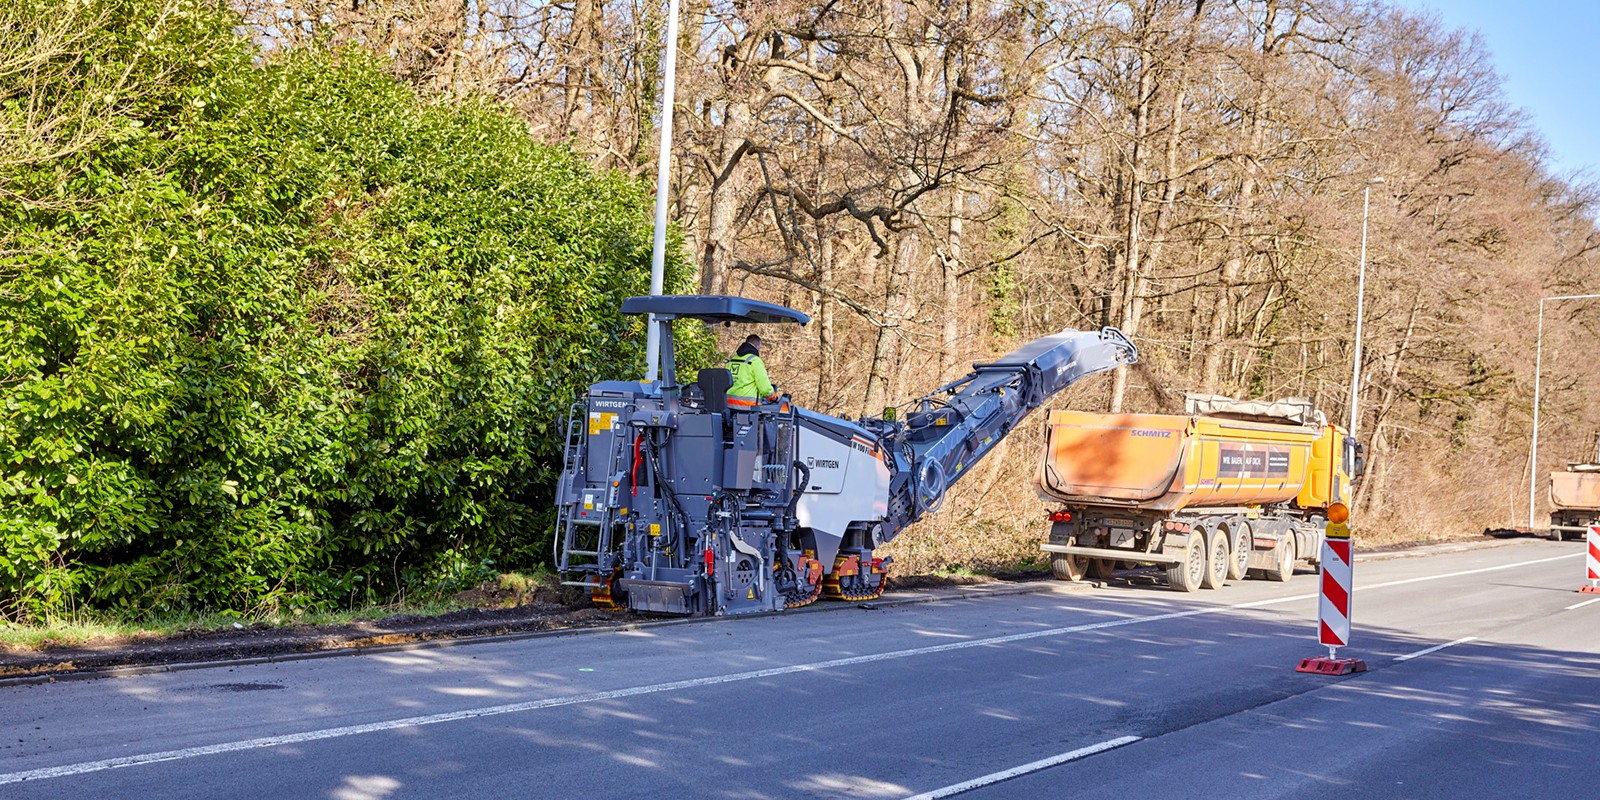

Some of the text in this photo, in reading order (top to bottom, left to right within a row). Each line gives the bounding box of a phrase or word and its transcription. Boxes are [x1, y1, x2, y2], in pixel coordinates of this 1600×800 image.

[595, 400, 628, 408] WIRTGEN
[1130, 429, 1172, 439] SCHMITZ
[857, 443, 865, 452] 100
[815, 459, 839, 469] WIRTGEN
[1115, 531, 1127, 544] A
